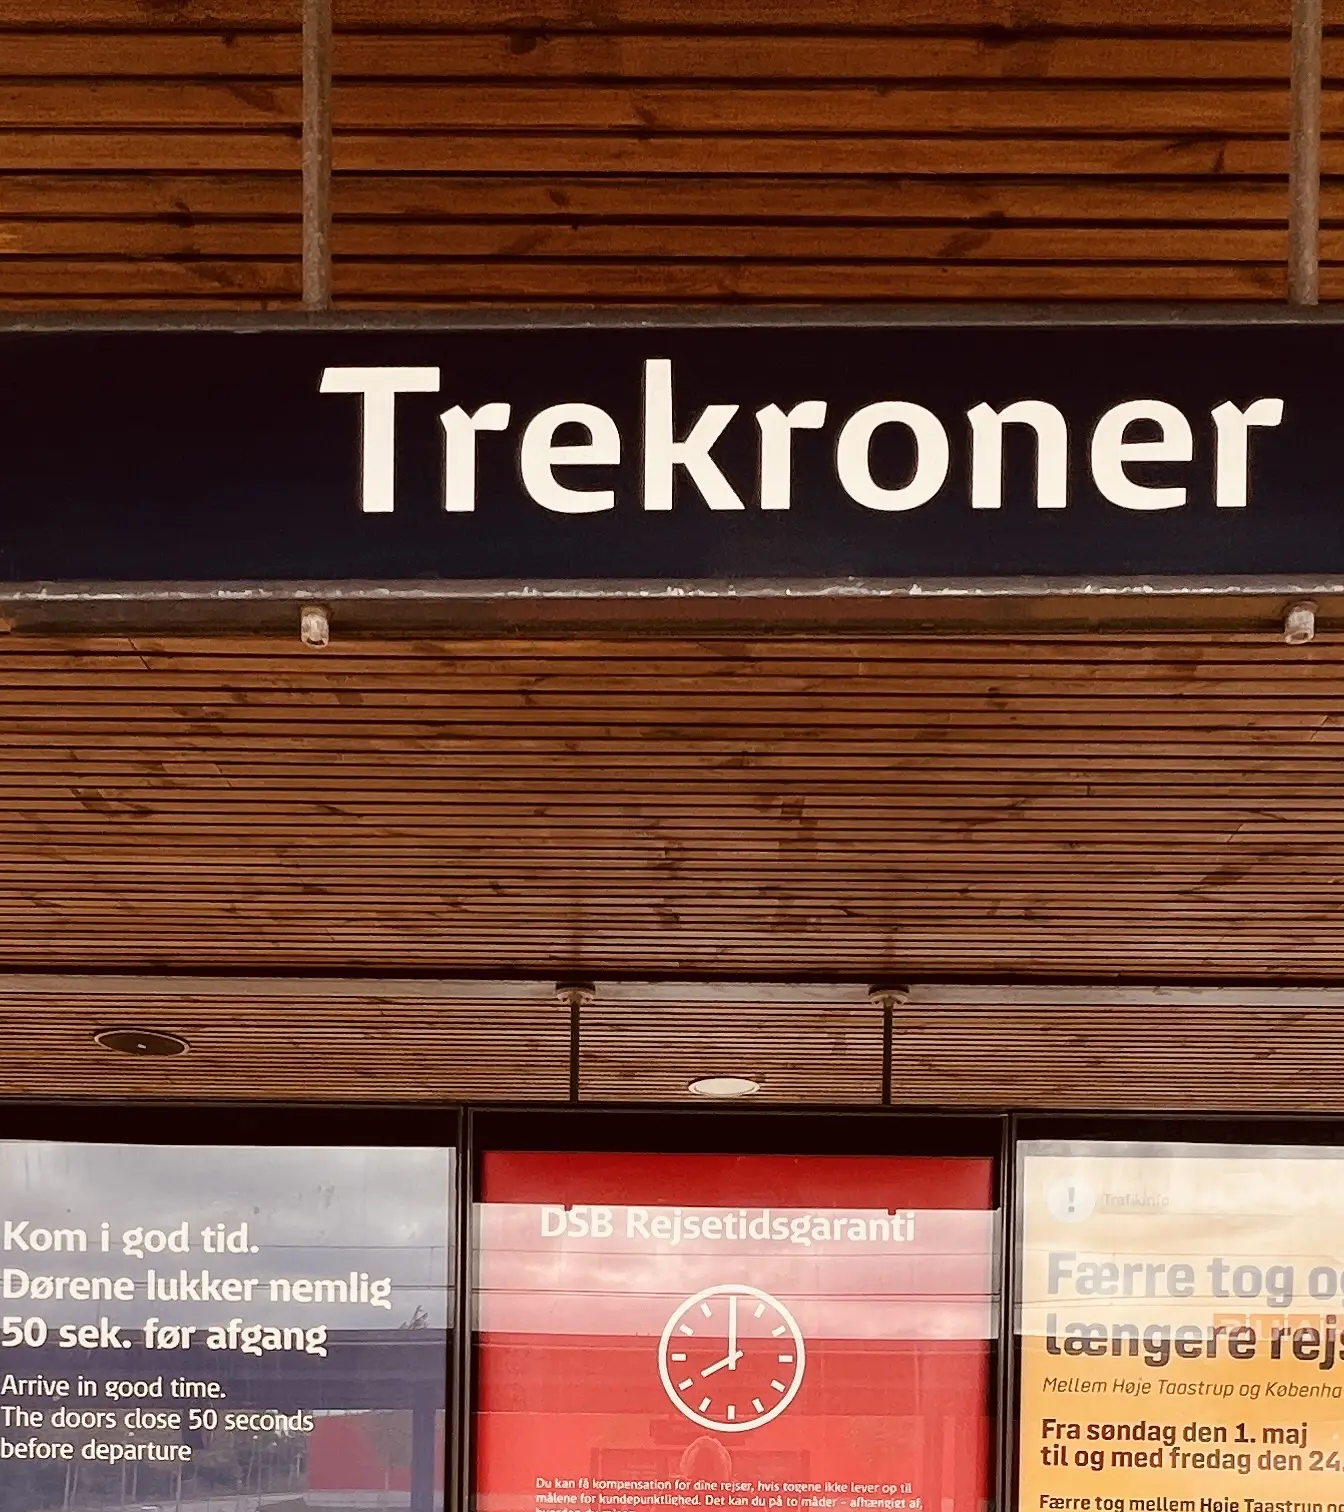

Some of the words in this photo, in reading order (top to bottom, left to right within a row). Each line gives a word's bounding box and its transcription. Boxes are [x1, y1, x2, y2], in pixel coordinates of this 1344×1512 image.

[318, 357, 1285, 513] Trekroner
[4, 1221, 86, 1251] Kom
[101, 1222, 108, 1251] i
[123, 1221, 188, 1259] god
[201, 1222, 260, 1253] tid.
[541, 1206, 613, 1238] DSB
[626, 1208, 915, 1246] Rejsetidsgaranti
[3, 1268, 134, 1300] Dørene
[147, 1269, 258, 1302] lukker
[270, 1271, 391, 1309] nemlig
[1047, 1251, 1195, 1299] Færre
[1206, 1256, 1294, 1308] tog
[2, 1317, 46, 1347] 50
[59, 1317, 132, 1349] sek.
[143, 1318, 196, 1349] før
[207, 1319, 326, 1357] afgang
[1046, 1312, 1257, 1367] længere
[1, 1374, 69, 1395] Arrive
[78, 1376, 96, 1396] in
[105, 1376, 162, 1400] good
[171, 1376, 225, 1398] time.
[1042, 1377, 1107, 1392] Mellem
[1112, 1378, 1151, 1396] Høje
[1158, 1379, 1234, 1398] Taastrup
[1238, 1384, 1261, 1400] og
[0, 1406, 43, 1430] The
[51, 1406, 116, 1428] doors
[125, 1407, 180, 1429] close
[189, 1408, 217, 1429] 50
[225, 1408, 313, 1433] seconds
[1041, 1418, 1080, 1439] Fra
[1086, 1419, 1176, 1446] søndag
[1182, 1421, 1226, 1442] den
[1234, 1422, 1255, 1443] 1.
[1262, 1421, 1307, 1448] maj
[1, 1437, 73, 1459] before
[82, 1438, 191, 1465] departure
[1040, 1444, 1068, 1466] til
[1074, 1450, 1104, 1470] og
[1111, 1447, 1162, 1468] med
[1169, 1446, 1250, 1473] fredag
[1257, 1449, 1301, 1470] den
[536, 1477, 551, 1488] Du
[555, 1478, 575, 1488] kan
[577, 1478, 589, 1488] få
[592, 1478, 671, 1491] kompensation
[674, 1479, 692, 1490] for
[693, 1480, 717, 1490] dine
[720, 1482, 754, 1493] rejser,
[757, 1480, 779, 1491] hvis
[783, 1482, 820, 1493] togene
[824, 1482, 848, 1492] ikke
[850, 1482, 878, 1495] lever
[881, 1484, 897, 1495] op
[900, 1484, 912, 1493] til
[1039, 1494, 1090, 1510] Færre
[1094, 1496, 1124, 1512] tog
[1129, 1496, 1195, 1512] mellem
